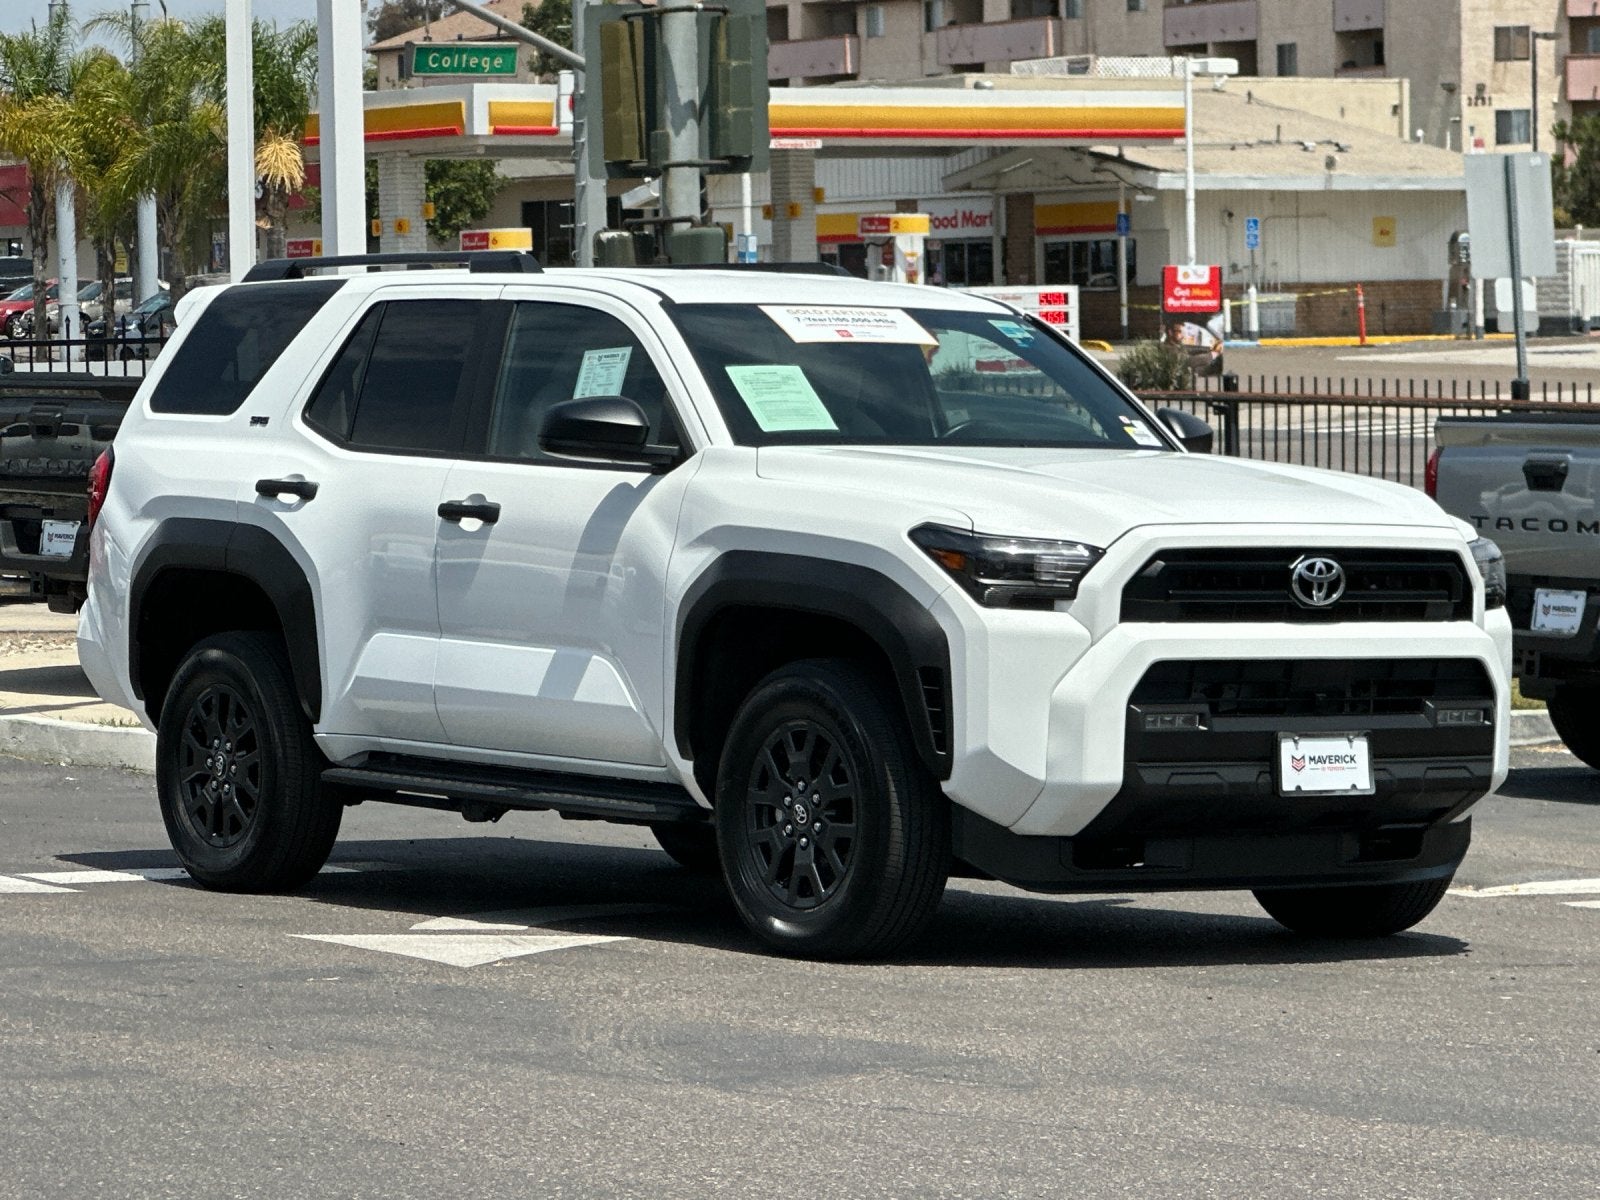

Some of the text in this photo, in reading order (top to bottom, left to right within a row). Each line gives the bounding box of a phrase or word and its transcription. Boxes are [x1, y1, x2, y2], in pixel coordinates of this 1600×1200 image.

[428, 52, 503, 72] College
[892, 219, 900, 230] 2
[1173, 286, 1191, 297] Get
[1167, 297, 1219, 307] Performance
[786, 308, 888, 318] GOLD CERTIFIED
[1469, 515, 1600, 535] TACOM
[1308, 754, 1357, 765] MAVERICK
